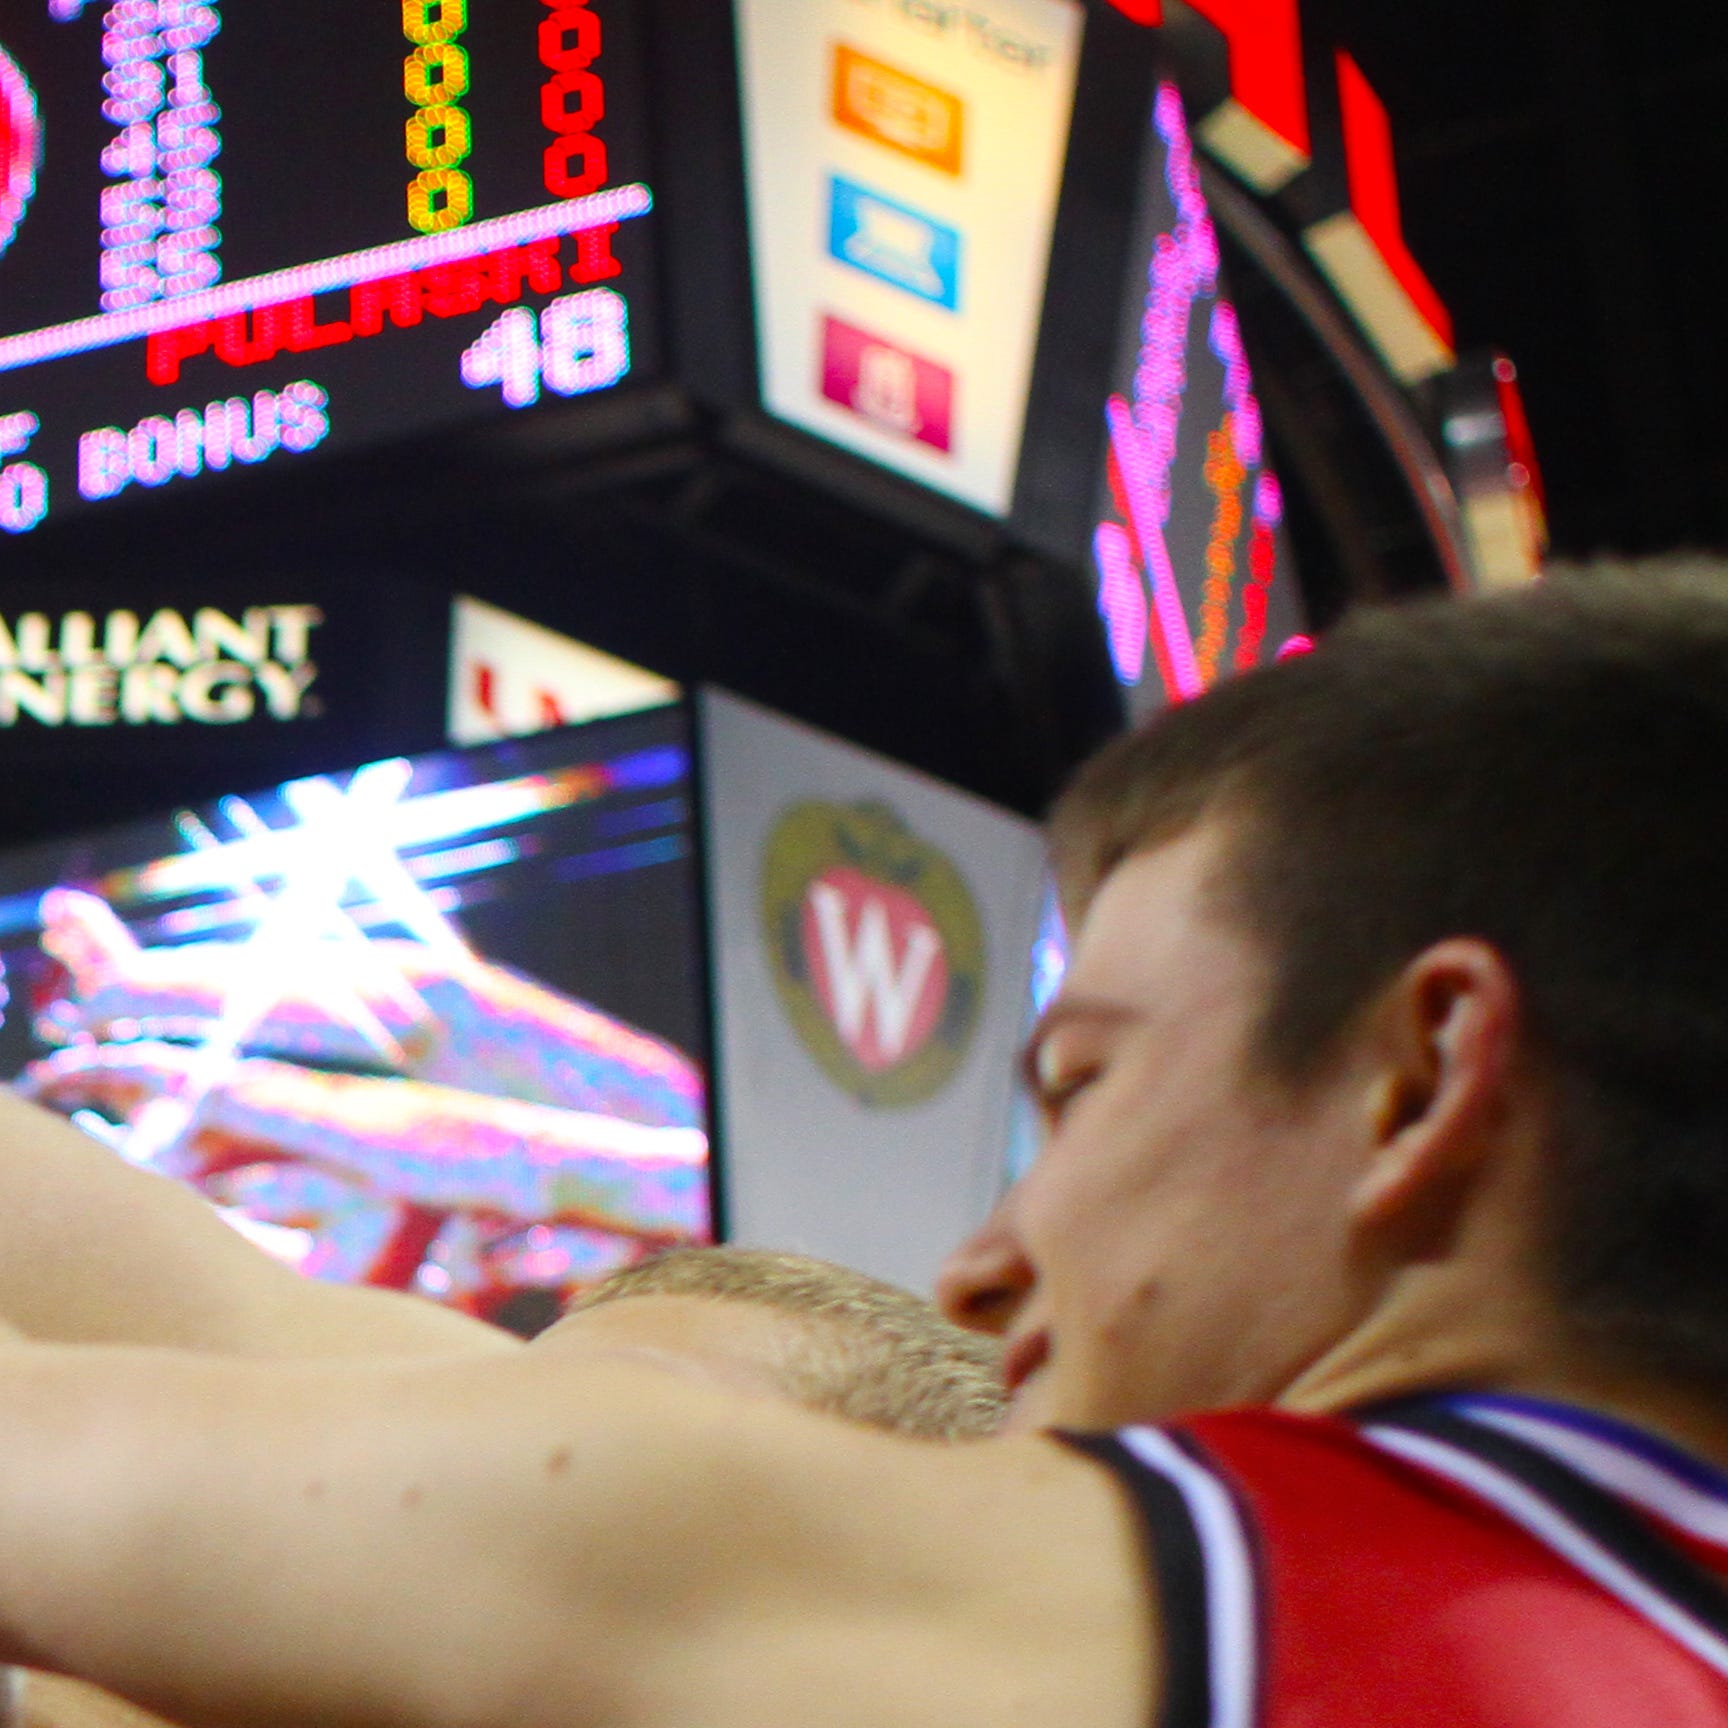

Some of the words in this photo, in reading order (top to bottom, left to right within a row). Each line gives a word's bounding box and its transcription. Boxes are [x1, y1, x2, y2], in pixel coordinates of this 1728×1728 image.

[404, 42, 469, 107] 0
[538, 7, 602, 72] 0
[405, 103, 471, 169] 0
[540, 69, 605, 135] 0
[407, 166, 474, 234] 0
[544, 132, 608, 199] 0
[460, 287, 630, 408] 48
[78, 379, 329, 500] BONUS
[810, 880, 940, 1060] W
